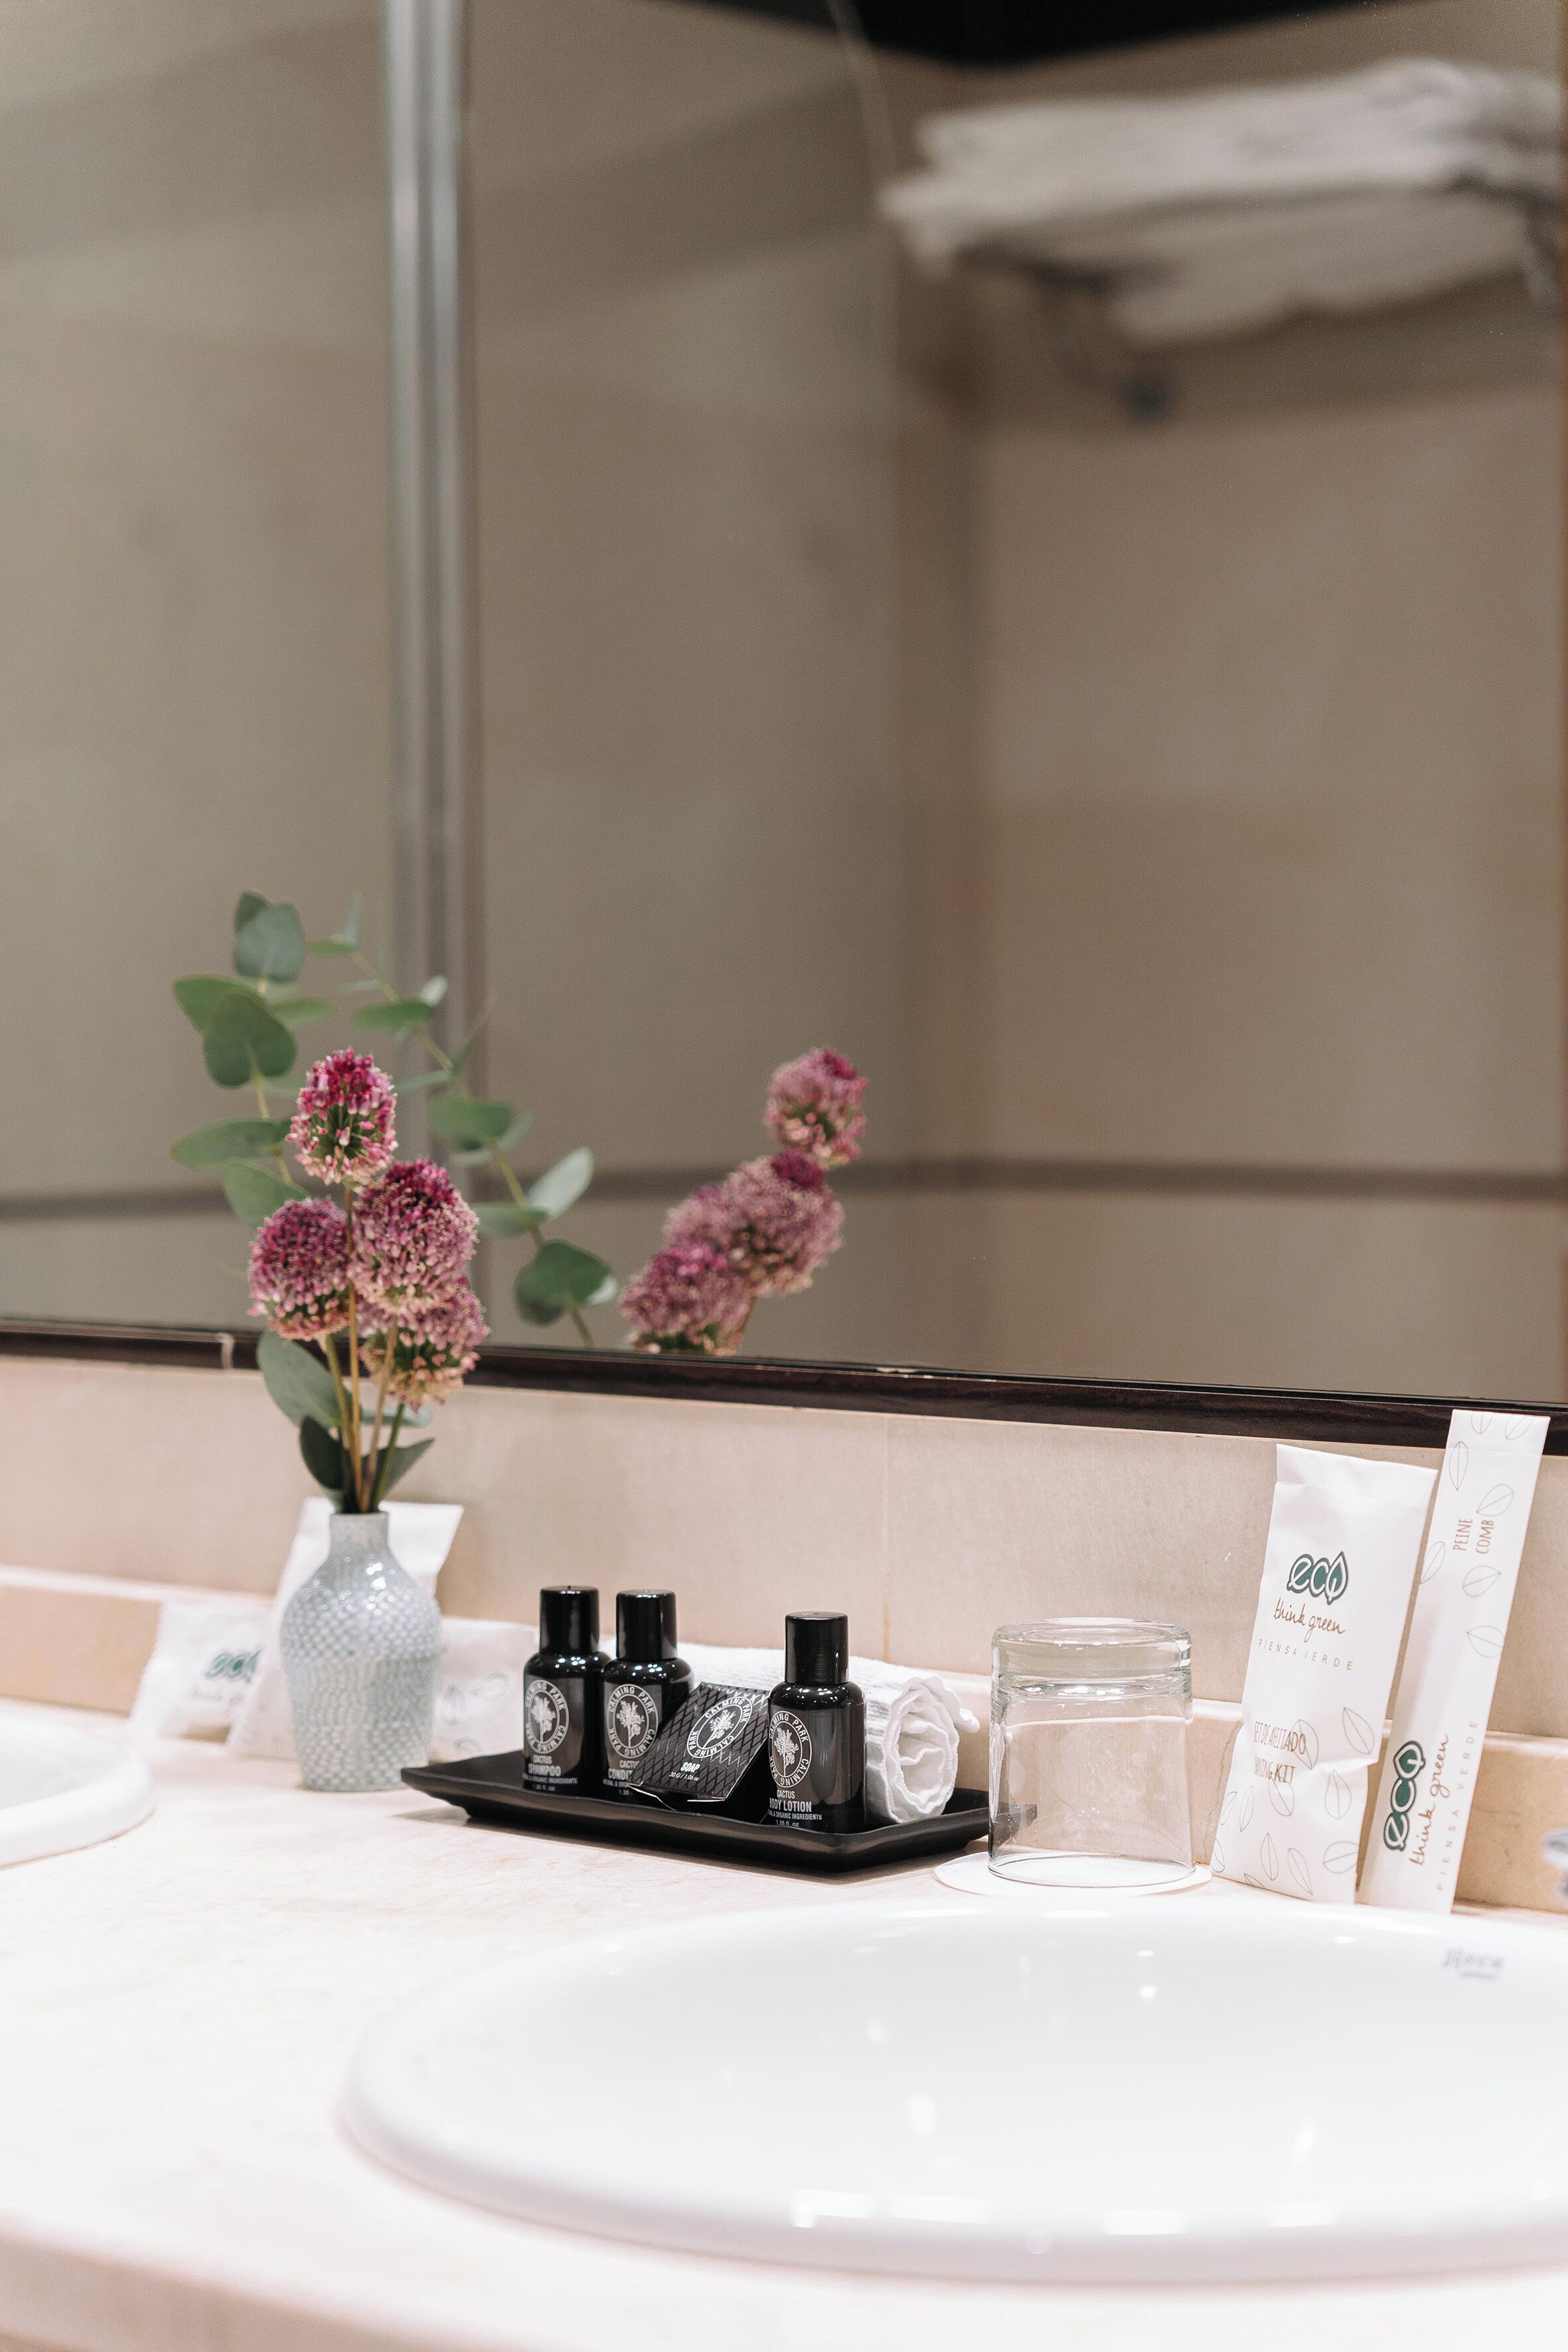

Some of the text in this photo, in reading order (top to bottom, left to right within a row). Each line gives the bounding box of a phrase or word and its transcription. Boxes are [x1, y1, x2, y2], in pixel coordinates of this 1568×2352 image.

[1452, 1518, 1473, 1551] PEINE
[1476, 1520, 1495, 1554] COMB
[1273, 1597, 1346, 1643] think green
[1258, 1638, 1355, 1671] PIENSA VERDE
[609, 1686, 656, 1714] CALMING PARK
[704, 1697, 751, 1723] CALMING PARK
[769, 1713, 809, 1743] CALMING PARK
[624, 1728, 655, 1757] CALMING
[688, 1730, 735, 1757] CALMING PARK
[619, 1760, 640, 1768] CACTU
[680, 1761, 700, 1773] SOAP
[780, 1758, 809, 1786] CALMING
[1274, 1763, 1296, 1783] KIT
[769, 1797, 812, 1812] BODY LOTION
[776, 1789, 795, 1799] CACTUS
[1408, 1733, 1450, 1866] think green
[1437, 1721, 1478, 1891] PIENSA VERDE
